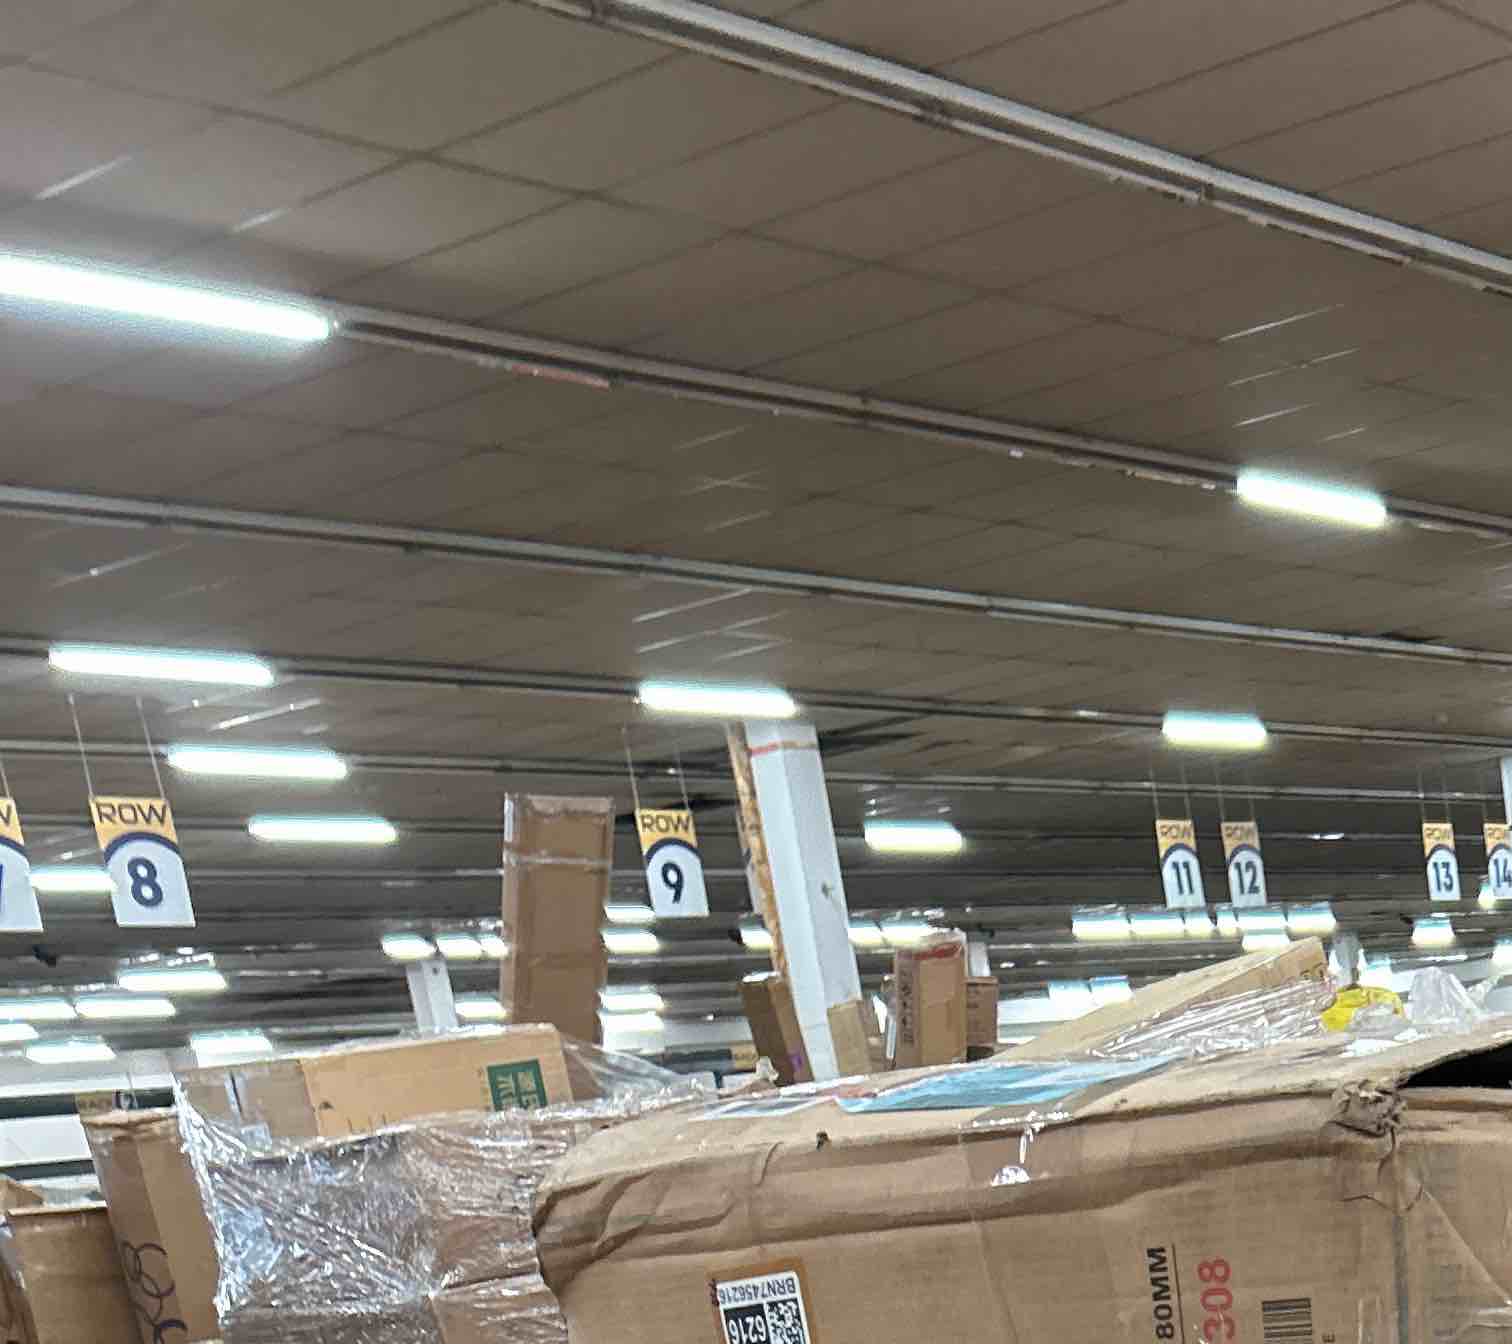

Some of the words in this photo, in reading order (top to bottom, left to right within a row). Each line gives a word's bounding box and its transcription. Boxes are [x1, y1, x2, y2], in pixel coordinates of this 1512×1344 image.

[95, 803, 168, 825] ROW
[640, 814, 690, 833] ROW
[127, 857, 163, 907] 8
[661, 861, 684, 904] 9
[1171, 861, 1195, 896] 11
[1233, 861, 1261, 895] 12
[1432, 861, 1454, 892] 13
[1493, 858, 1512, 888] 14
